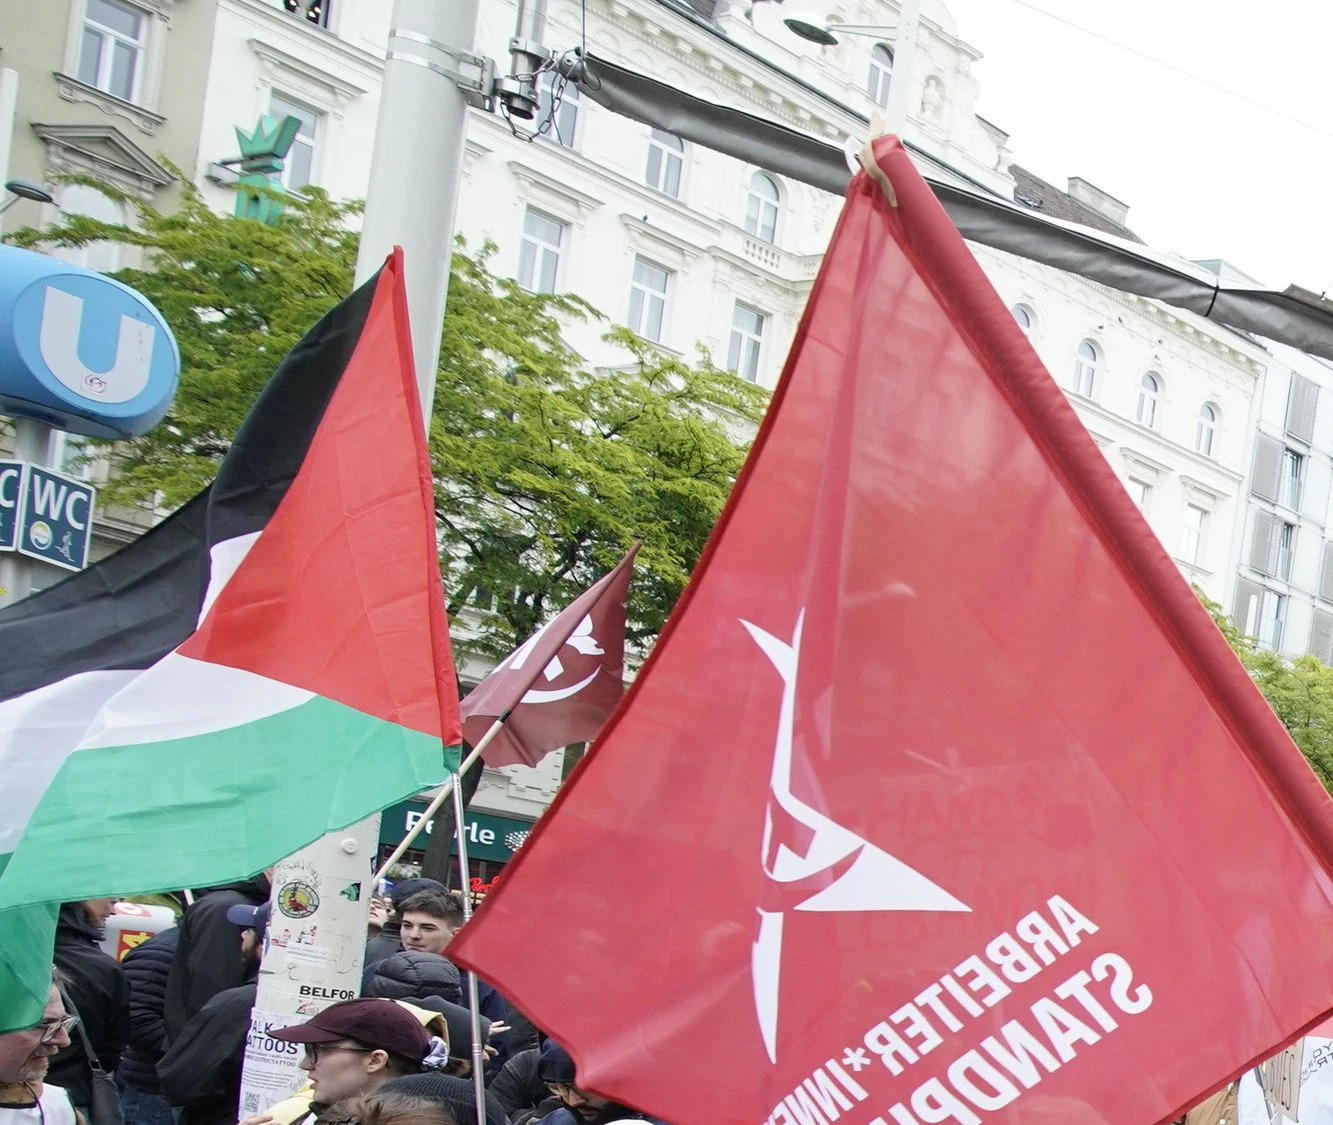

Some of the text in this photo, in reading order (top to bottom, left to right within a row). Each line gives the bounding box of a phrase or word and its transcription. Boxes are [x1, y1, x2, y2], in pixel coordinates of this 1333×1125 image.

[39, 285, 156, 404] U
[33, 473, 88, 530] WC
[300, 985, 355, 999] BELFOR
